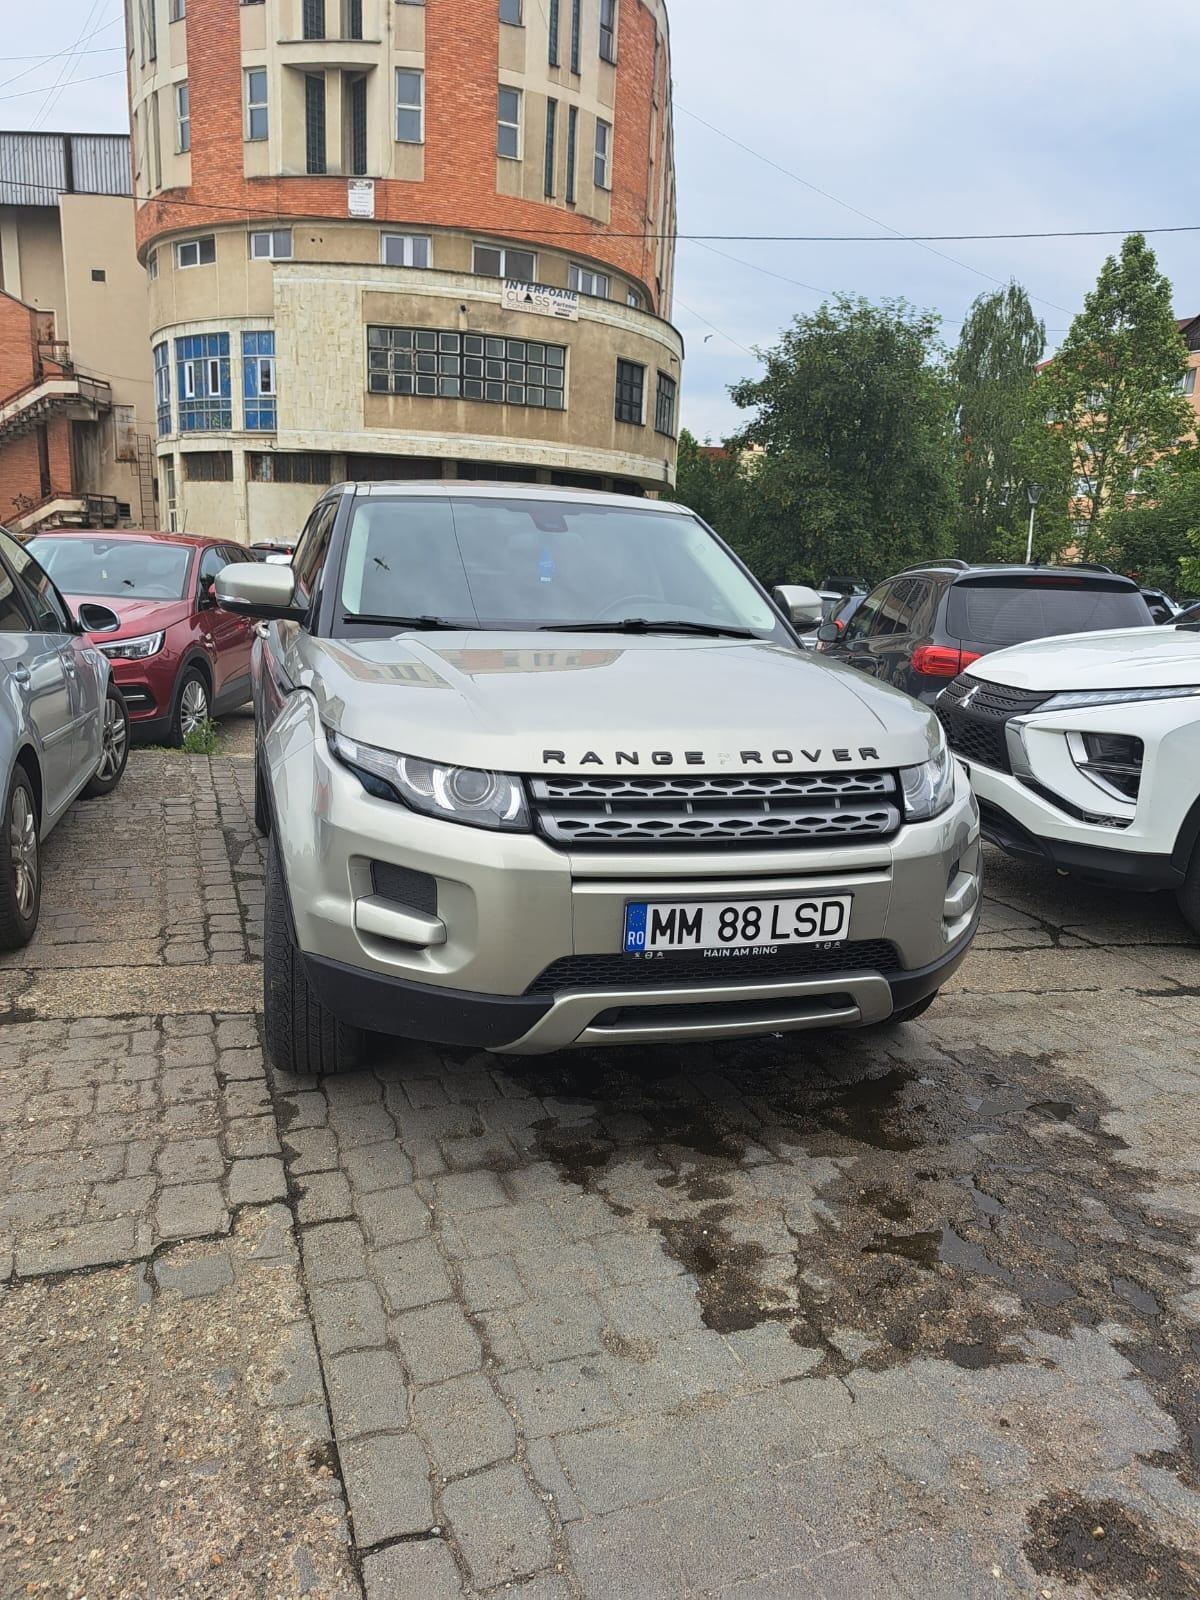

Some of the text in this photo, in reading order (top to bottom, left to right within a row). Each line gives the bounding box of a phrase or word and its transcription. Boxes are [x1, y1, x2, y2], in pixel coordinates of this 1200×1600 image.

[504, 279, 577, 302] INTERFOANE
[506, 290, 550, 307] CLASS
[542, 747, 881, 765] RANGE ROVER
[650, 900, 845, 945] MM 88 LSD
[628, 931, 644, 946] RO
[703, 946, 778, 958] HAIN AM RING
